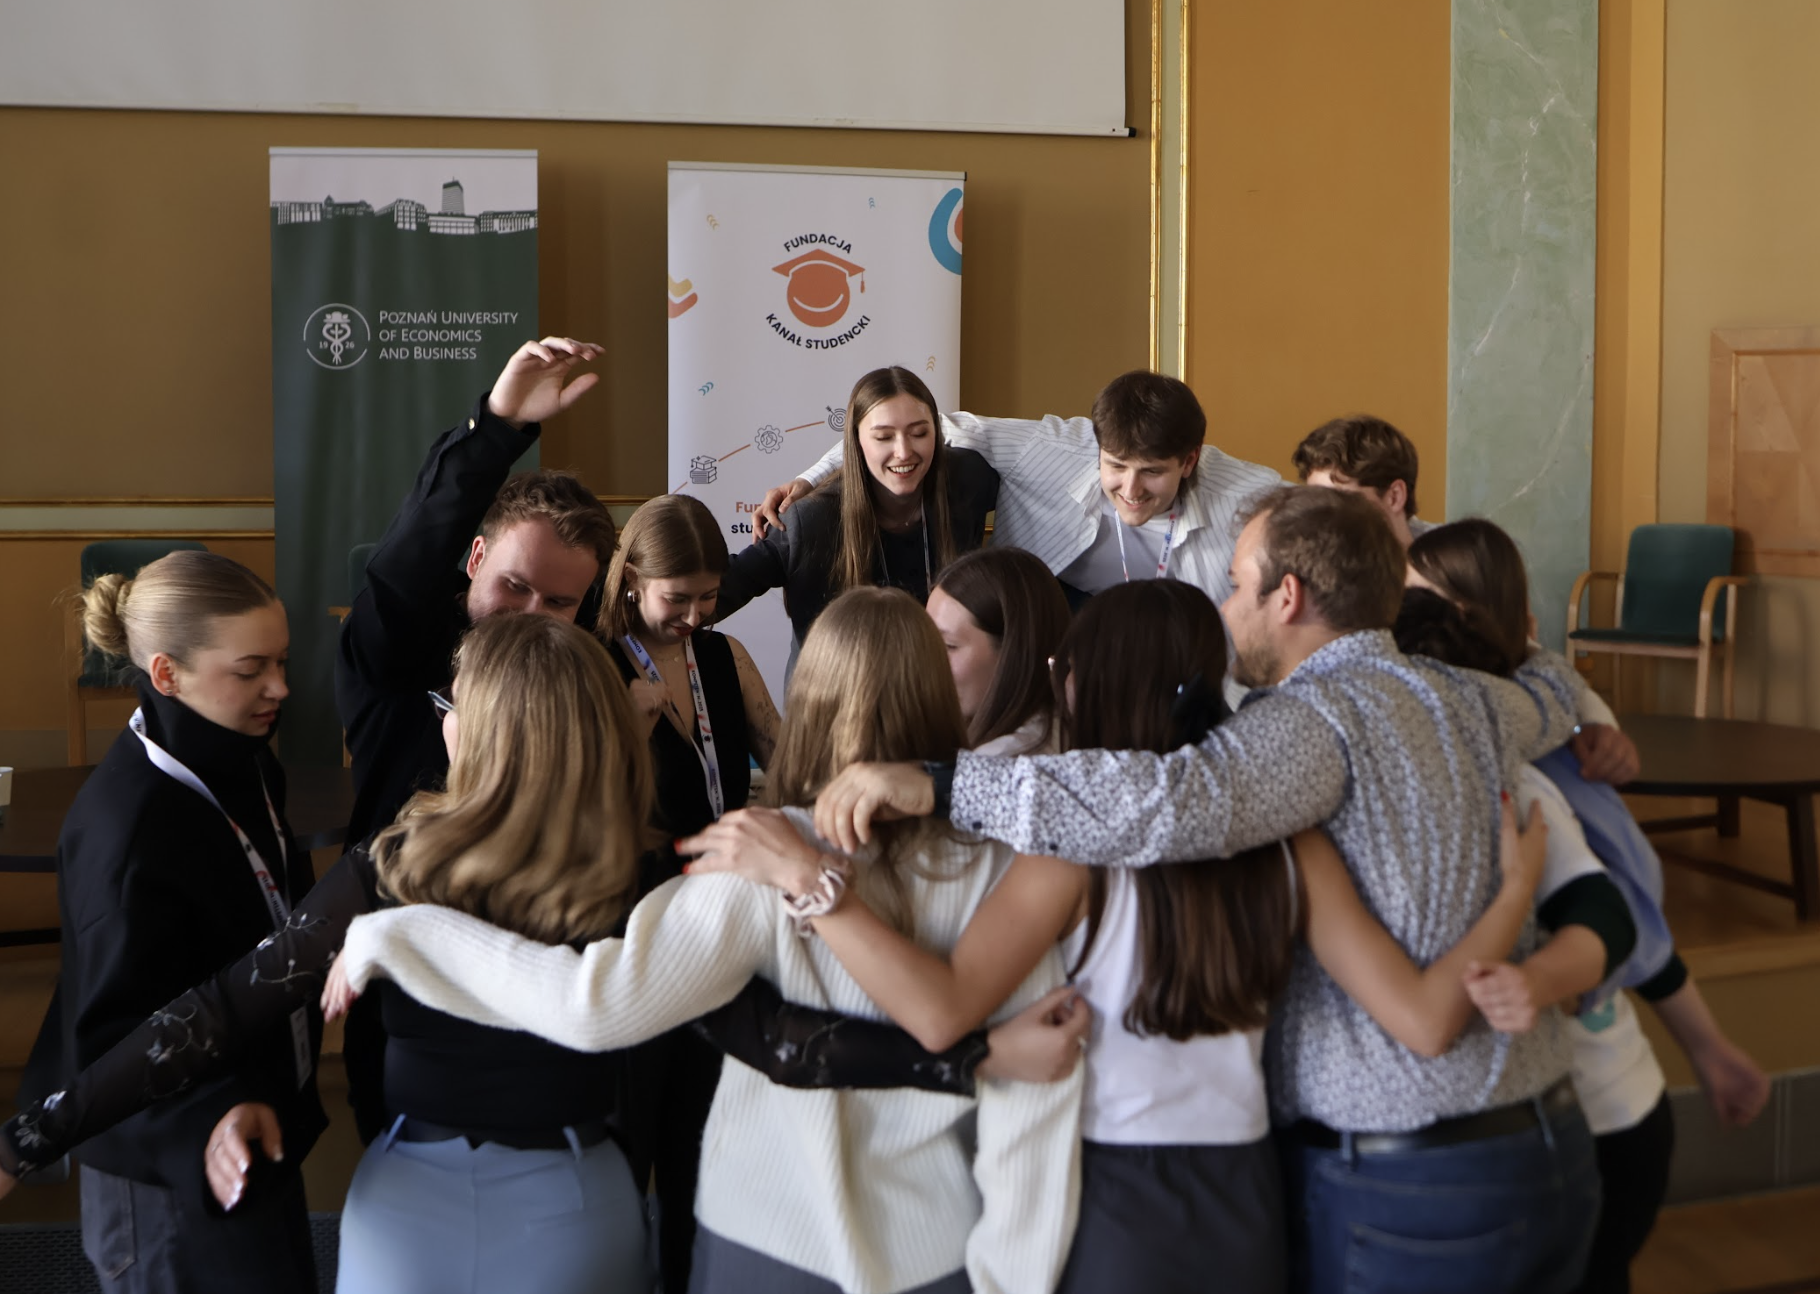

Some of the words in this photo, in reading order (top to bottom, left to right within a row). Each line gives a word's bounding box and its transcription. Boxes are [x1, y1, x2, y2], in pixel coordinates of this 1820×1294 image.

[784, 233, 852, 254] FUNDACJA
[379, 309, 437, 325] POZNAŃ
[441, 311, 518, 325] UNIVERSITY
[379, 329, 397, 342] OF
[401, 328, 482, 342] ECONOMICS
[765, 312, 803, 347] KANAŁ
[804, 314, 872, 350] STUDENCKI
[319, 341, 329, 349] 19
[345, 341, 355, 349] 26
[379, 347, 410, 360] AND
[413, 347, 477, 360] BUSINESS
